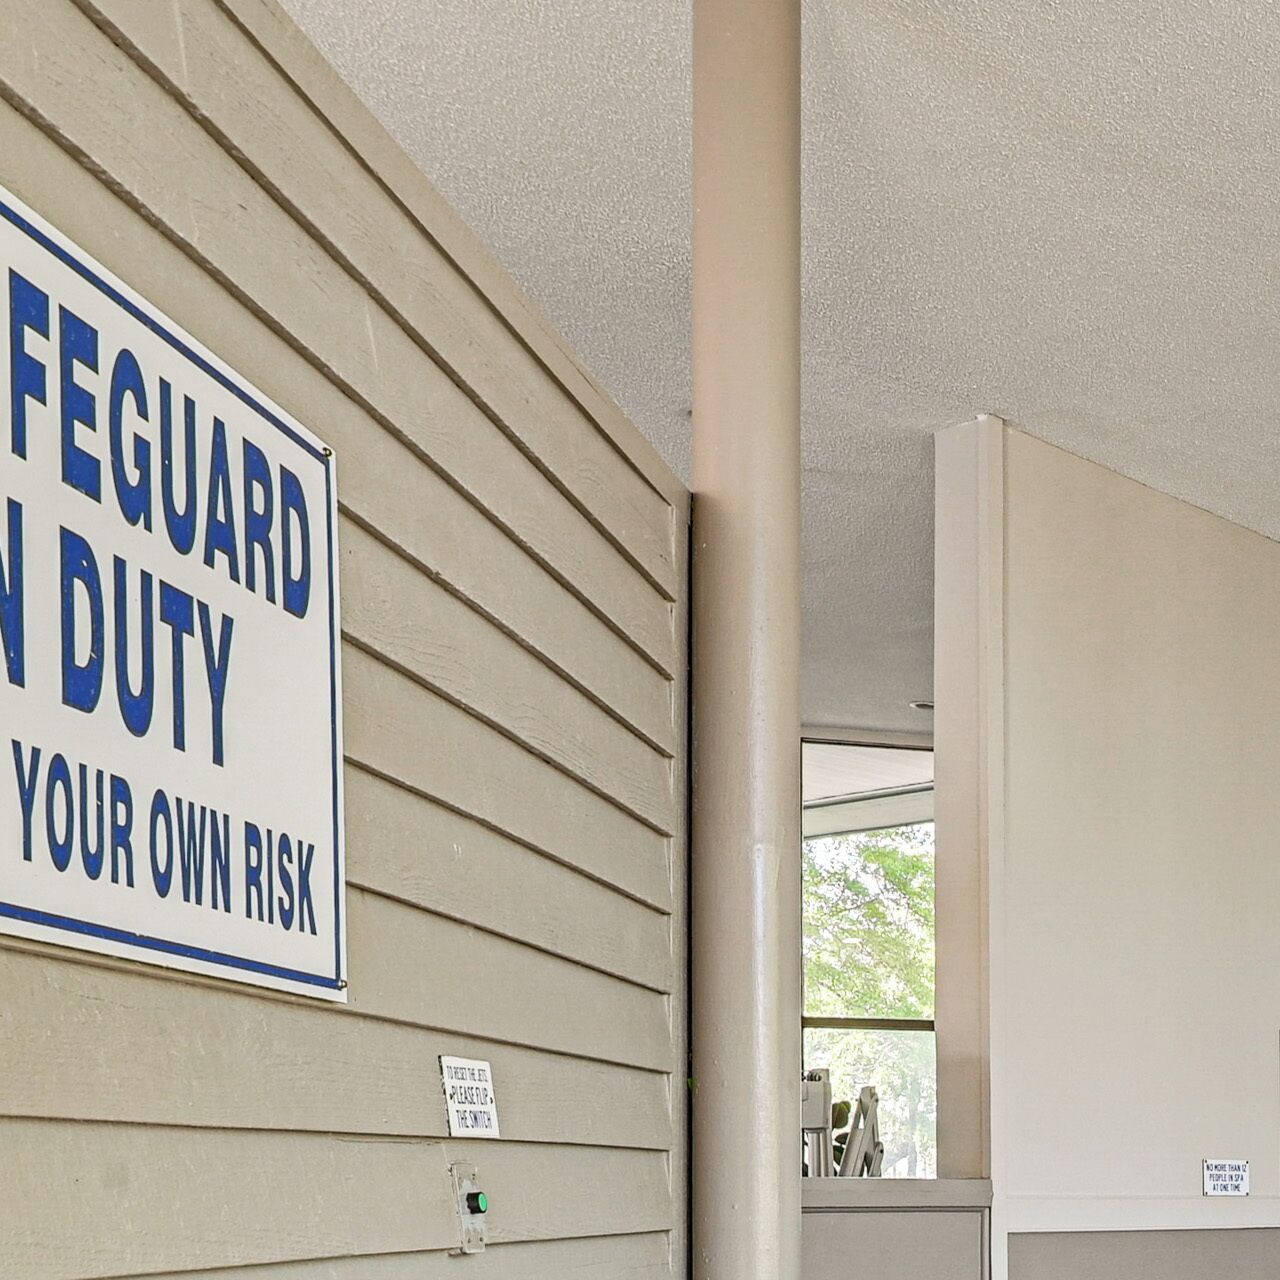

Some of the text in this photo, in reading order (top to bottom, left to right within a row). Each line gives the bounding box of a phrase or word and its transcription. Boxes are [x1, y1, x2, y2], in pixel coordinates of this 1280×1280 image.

[60, 522, 235, 768] DUTY
[12, 739, 318, 936] YOUR OWN RISK
[468, 1067, 476, 1081] THE
[452, 1086, 488, 1105] PLEASE FLIP
[456, 1109, 492, 1128] THE SWITCH
